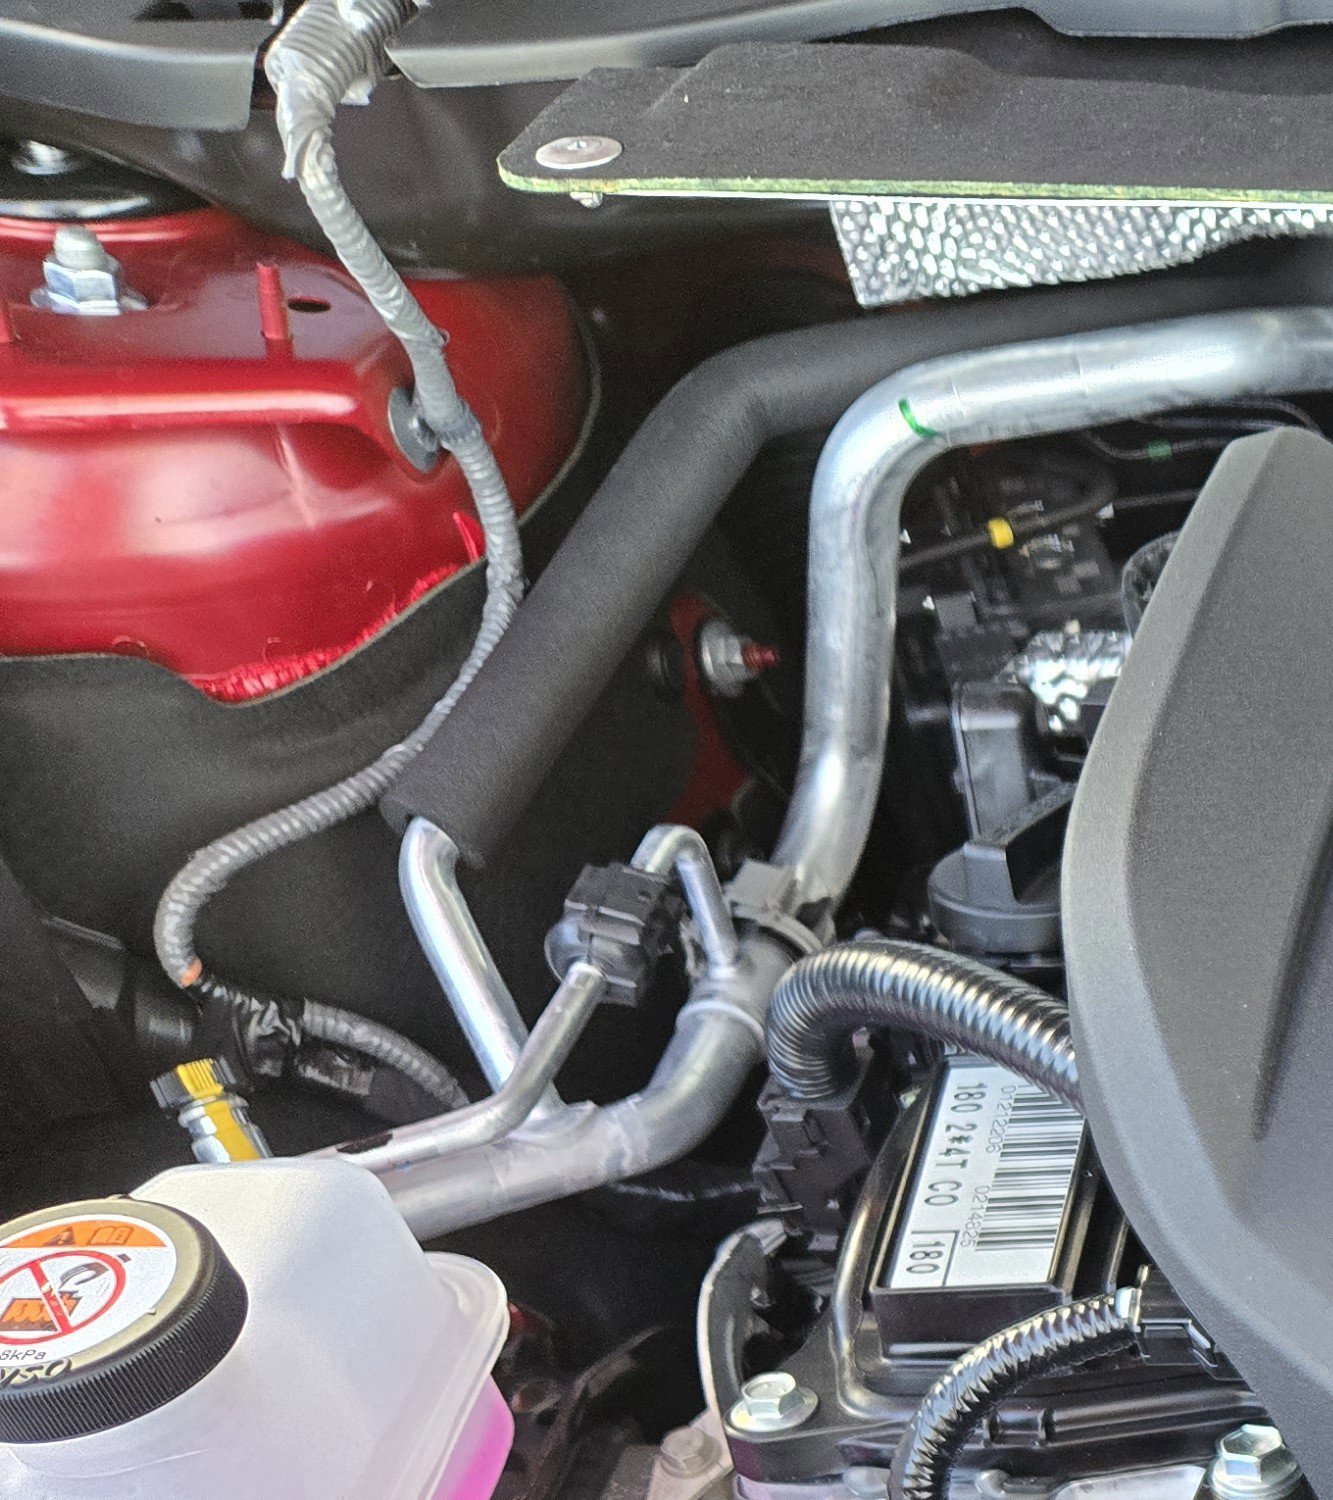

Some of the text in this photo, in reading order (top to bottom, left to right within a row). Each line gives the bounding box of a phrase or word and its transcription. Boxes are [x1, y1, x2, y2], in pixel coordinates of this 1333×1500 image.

[950, 1082, 987, 1114] 180
[959, 1184, 991, 1248] 0214825
[905, 1239, 945, 1276] 180
